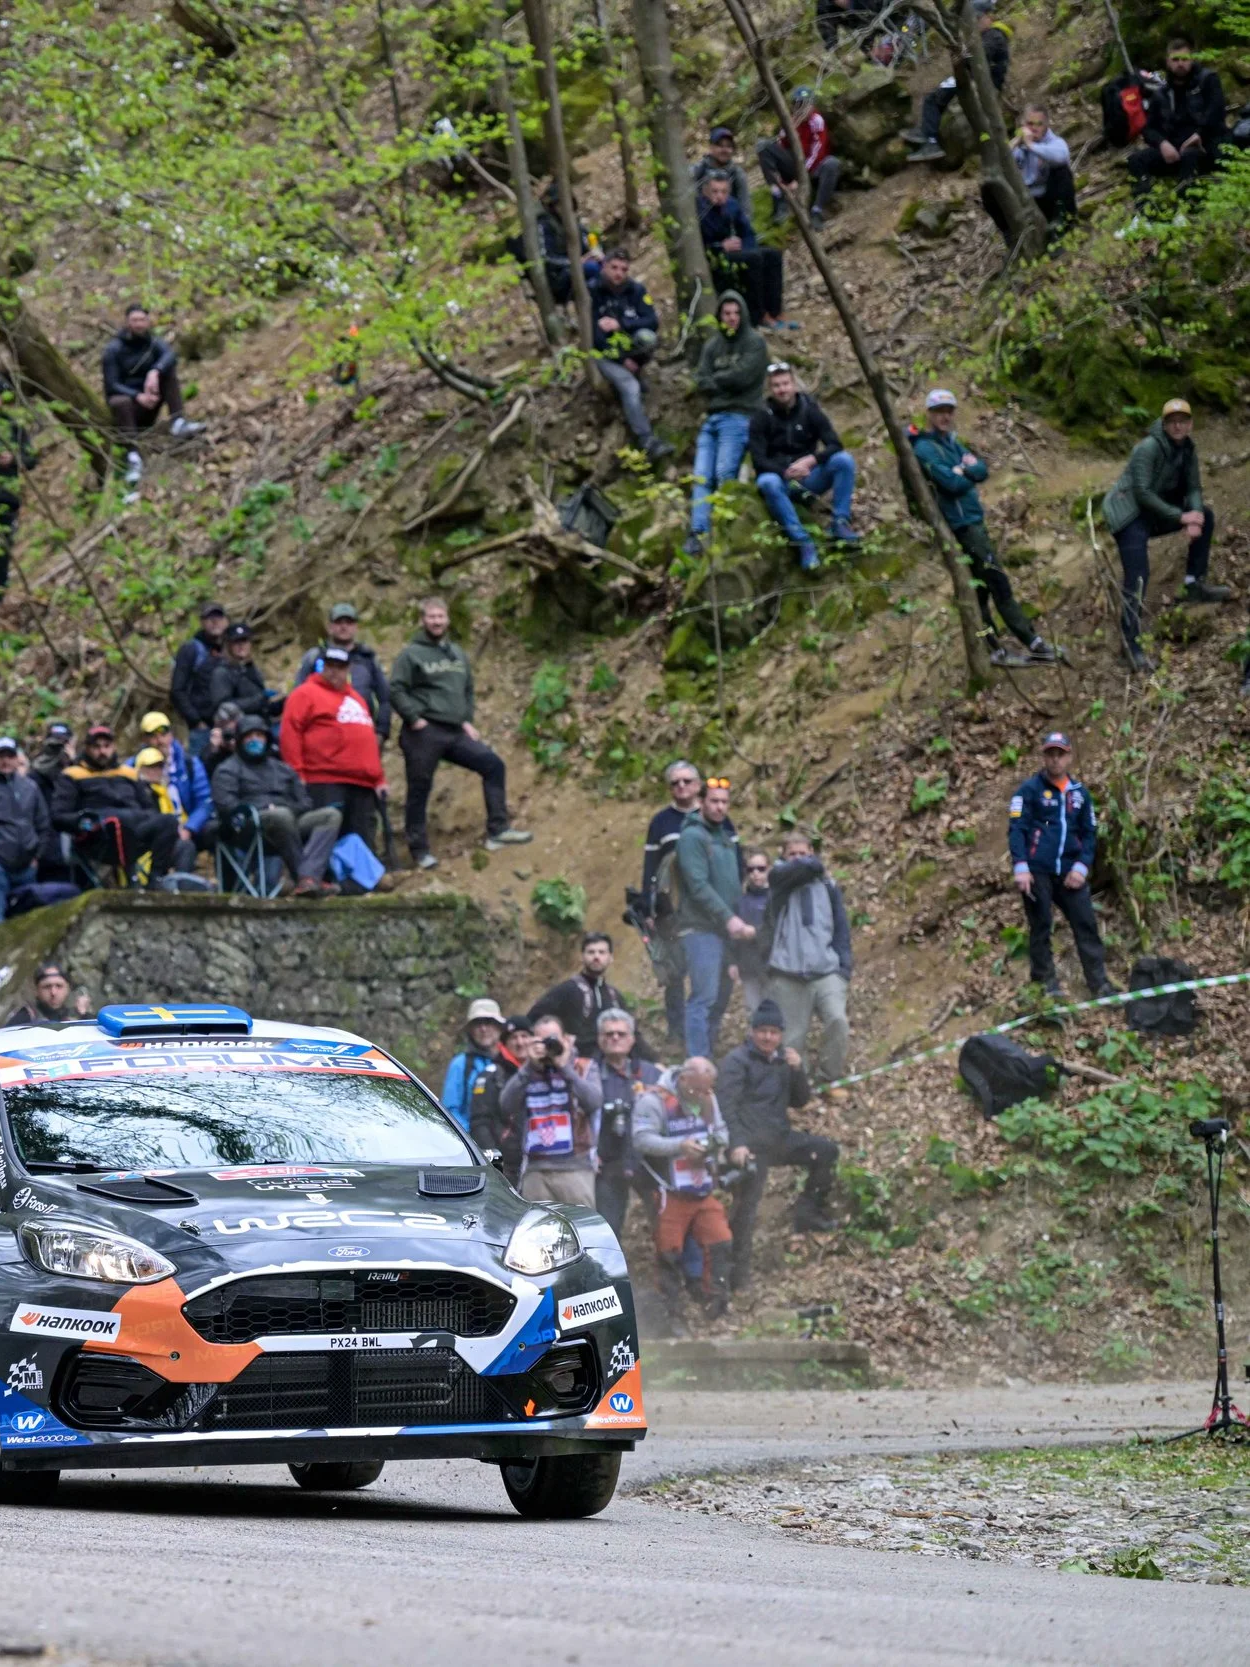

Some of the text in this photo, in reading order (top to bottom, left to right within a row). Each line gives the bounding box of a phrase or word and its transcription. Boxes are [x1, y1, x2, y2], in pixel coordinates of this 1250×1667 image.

[79, 1052, 378, 1072] FORUM8
[213, 1211, 451, 1235] WRC2
[335, 1247, 363, 1257] Ford
[367, 1271, 410, 1282] Rally2
[330, 1336, 382, 1348] PX24 BWL
[612, 1396, 631, 1411] W
[16, 1414, 43, 1430] W
[6, 1434, 78, 1444] West2000.se
